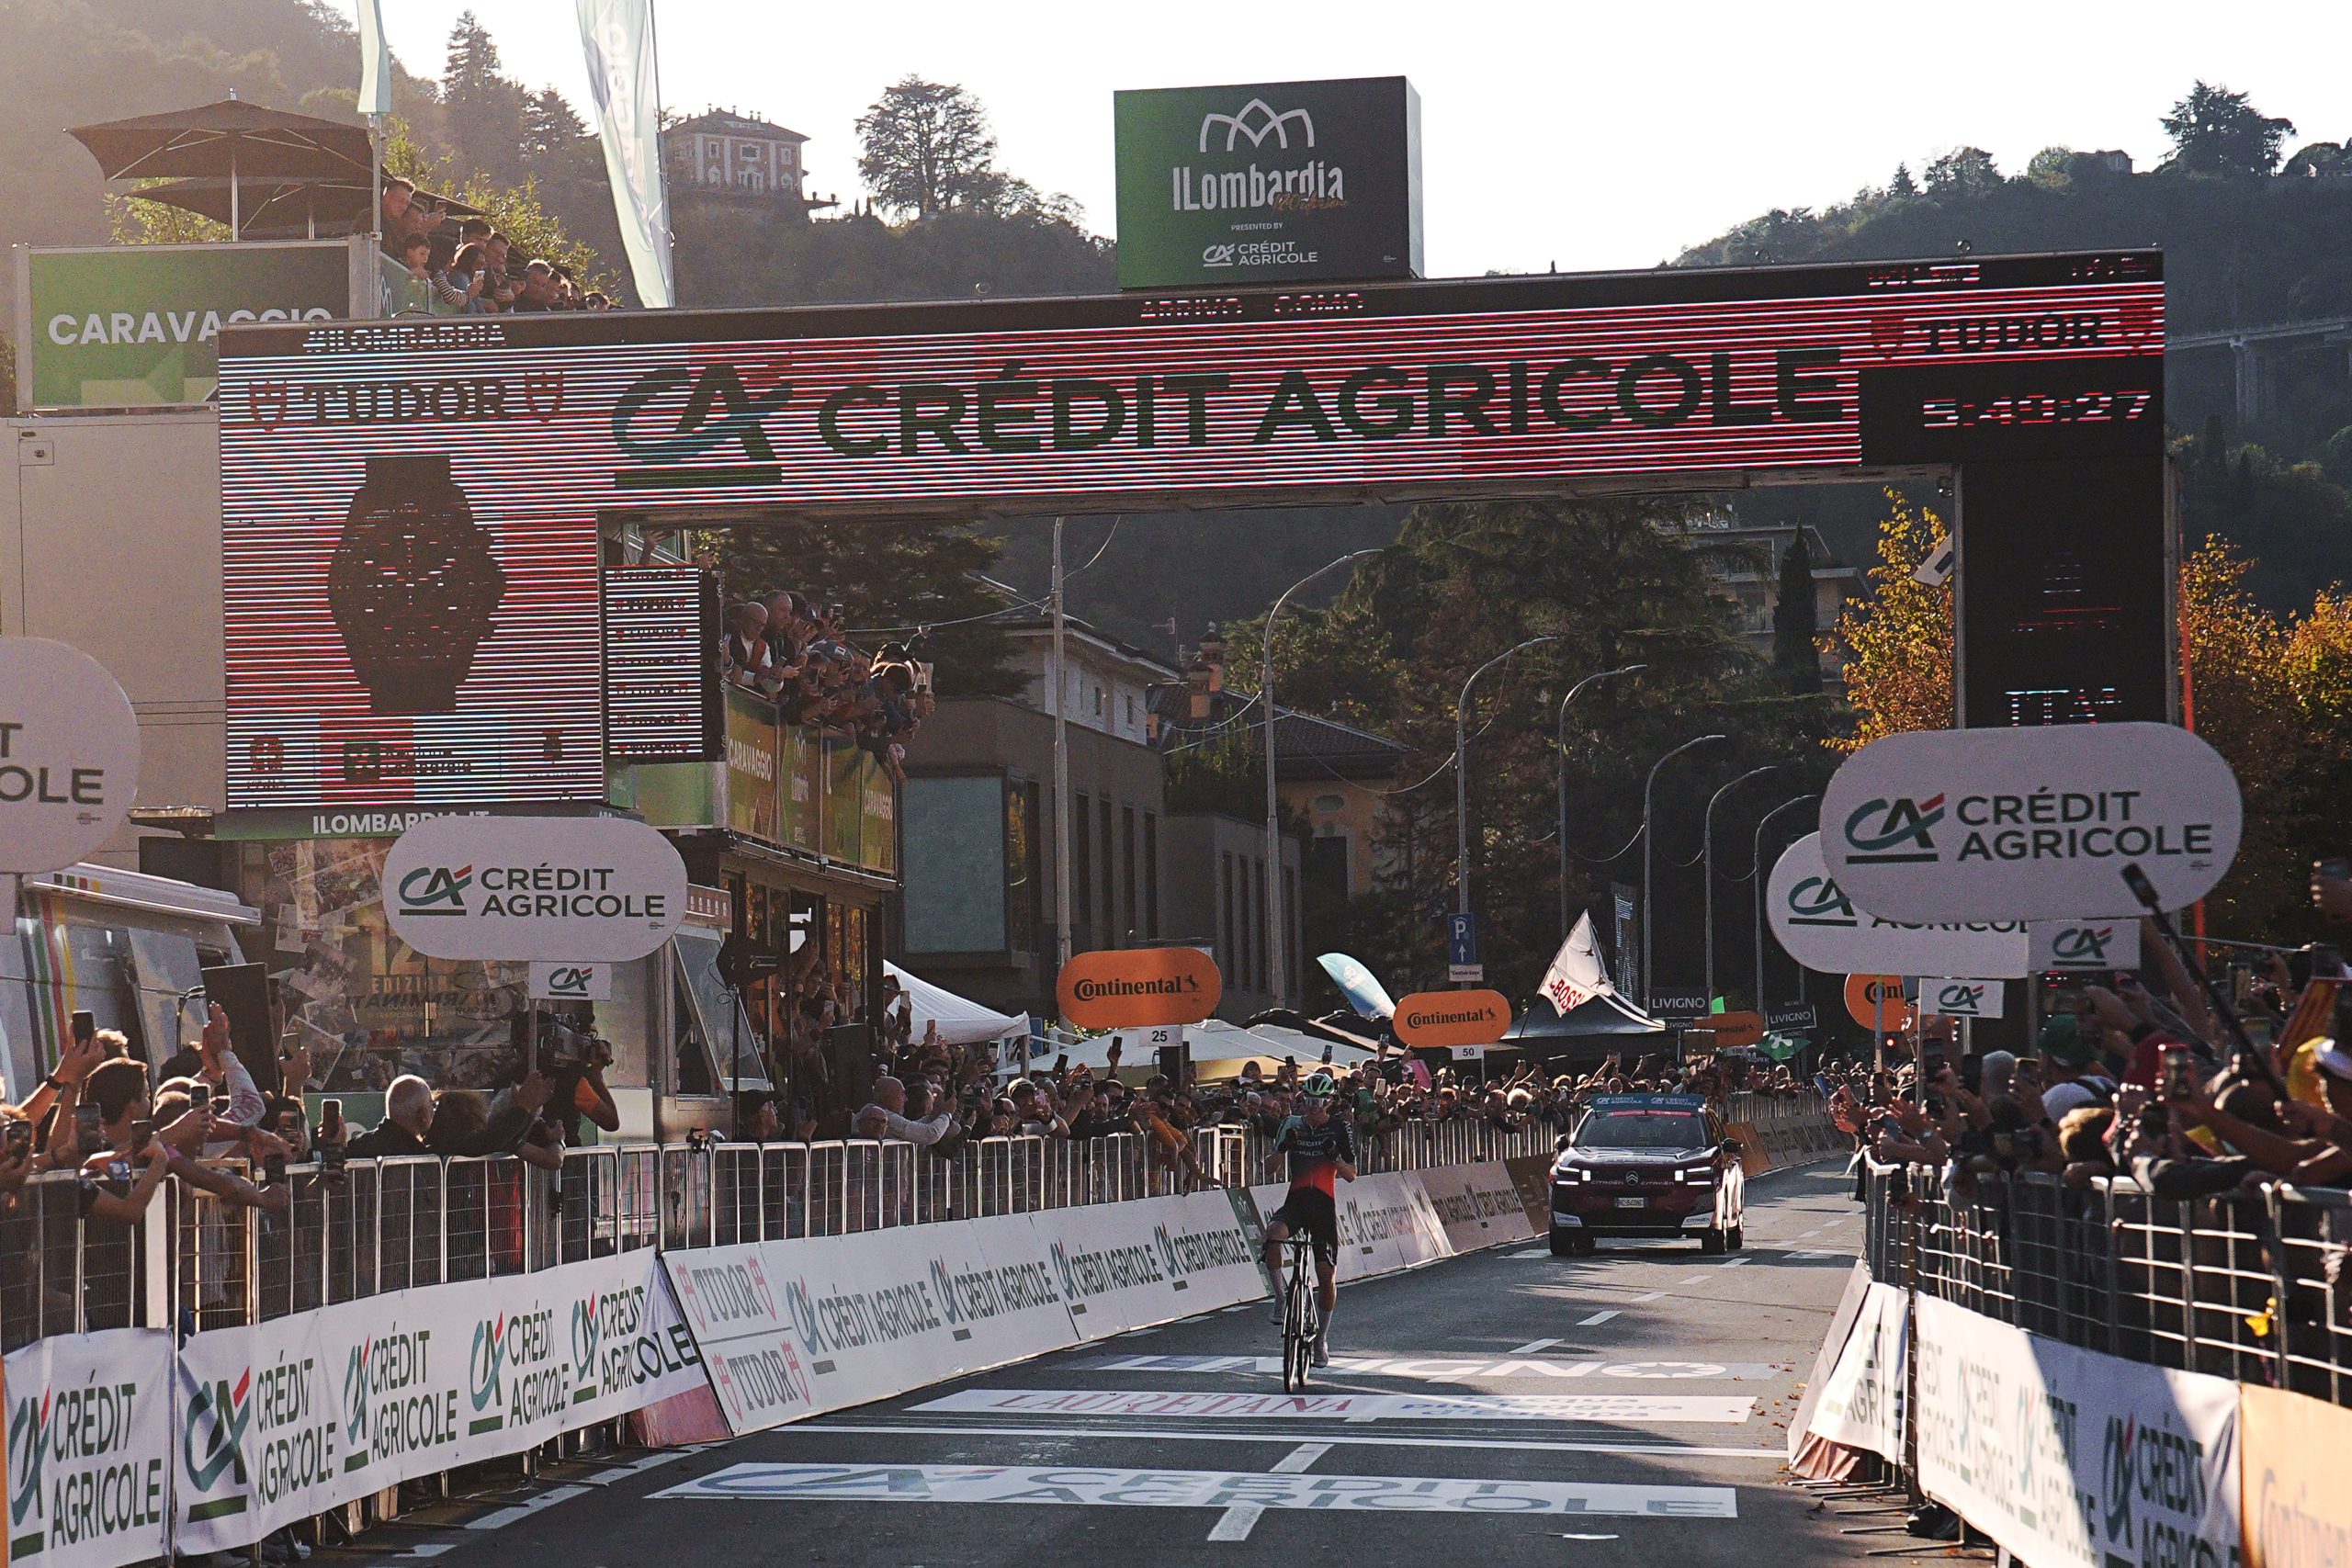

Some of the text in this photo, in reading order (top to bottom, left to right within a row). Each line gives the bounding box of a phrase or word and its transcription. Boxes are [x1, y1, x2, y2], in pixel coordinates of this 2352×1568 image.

[1231, 223, 1272, 231] PRESENTED
[1238, 241, 1295, 254] CRÉDIT
[1238, 252, 1317, 266] AGRICOLE
[49, 308, 333, 345] CARAVA
[1926, 317, 2099, 352] TUDOR
[304, 379, 505, 423] TUDOR
[818, 348, 1843, 457] CRÉDIT AGRICOLE
[729, 738, 773, 781] CARAVAGGIO
[1957, 787, 2141, 826] CRÉDIT
[1957, 823, 2212, 862] AGRICOLE
[481, 863, 615, 891] CRÉDIT
[480, 895, 665, 919] AGRICOLE
[1073, 975, 1182, 1002] Continental
[1652, 998, 1706, 1010] LIVIGNO
[1151, 1031, 1169, 1043] 25
[1407, 1010, 1484, 1030] Continental
[1770, 1010, 1811, 1024] LIVIGNO
[1463, 1047, 1475, 1057] 50
[1070, 1244, 1109, 1297] CRÉDIT
[1103, 1244, 1164, 1292] AGRICOLE
[1200, 1228, 1251, 1270] AGRICOLE
[600, 1279, 644, 1341] CRÉDIT
[692, 1263, 764, 1324] TUDOR
[954, 1262, 1004, 1321] CRÉDIT
[995, 1261, 1059, 1315] AGRICOLE
[508, 1300, 555, 1368] CRÉDIT
[818, 1283, 878, 1351] CRÉDIT
[871, 1280, 941, 1344] AGRICOLE
[370, 1321, 431, 1396] CRÉDIT
[601, 1323, 700, 1397] AGRICOLE
[257, 1350, 313, 1434] CRÉDIT
[509, 1363, 569, 1428] AGRICOLE
[727, 1349, 799, 1412] TUDOR
[54, 1370, 137, 1463] CRÉDIT
[372, 1389, 458, 1463] AGRICOLE
[992, 1393, 1353, 1416] LAURETANA
[258, 1422, 336, 1514] AGRICOLE
[2138, 1412, 2208, 1520] CRÉDIT
[51, 1459, 162, 1550] AGRICOLE
[982, 1486, 1727, 1517] AGRICOLE
